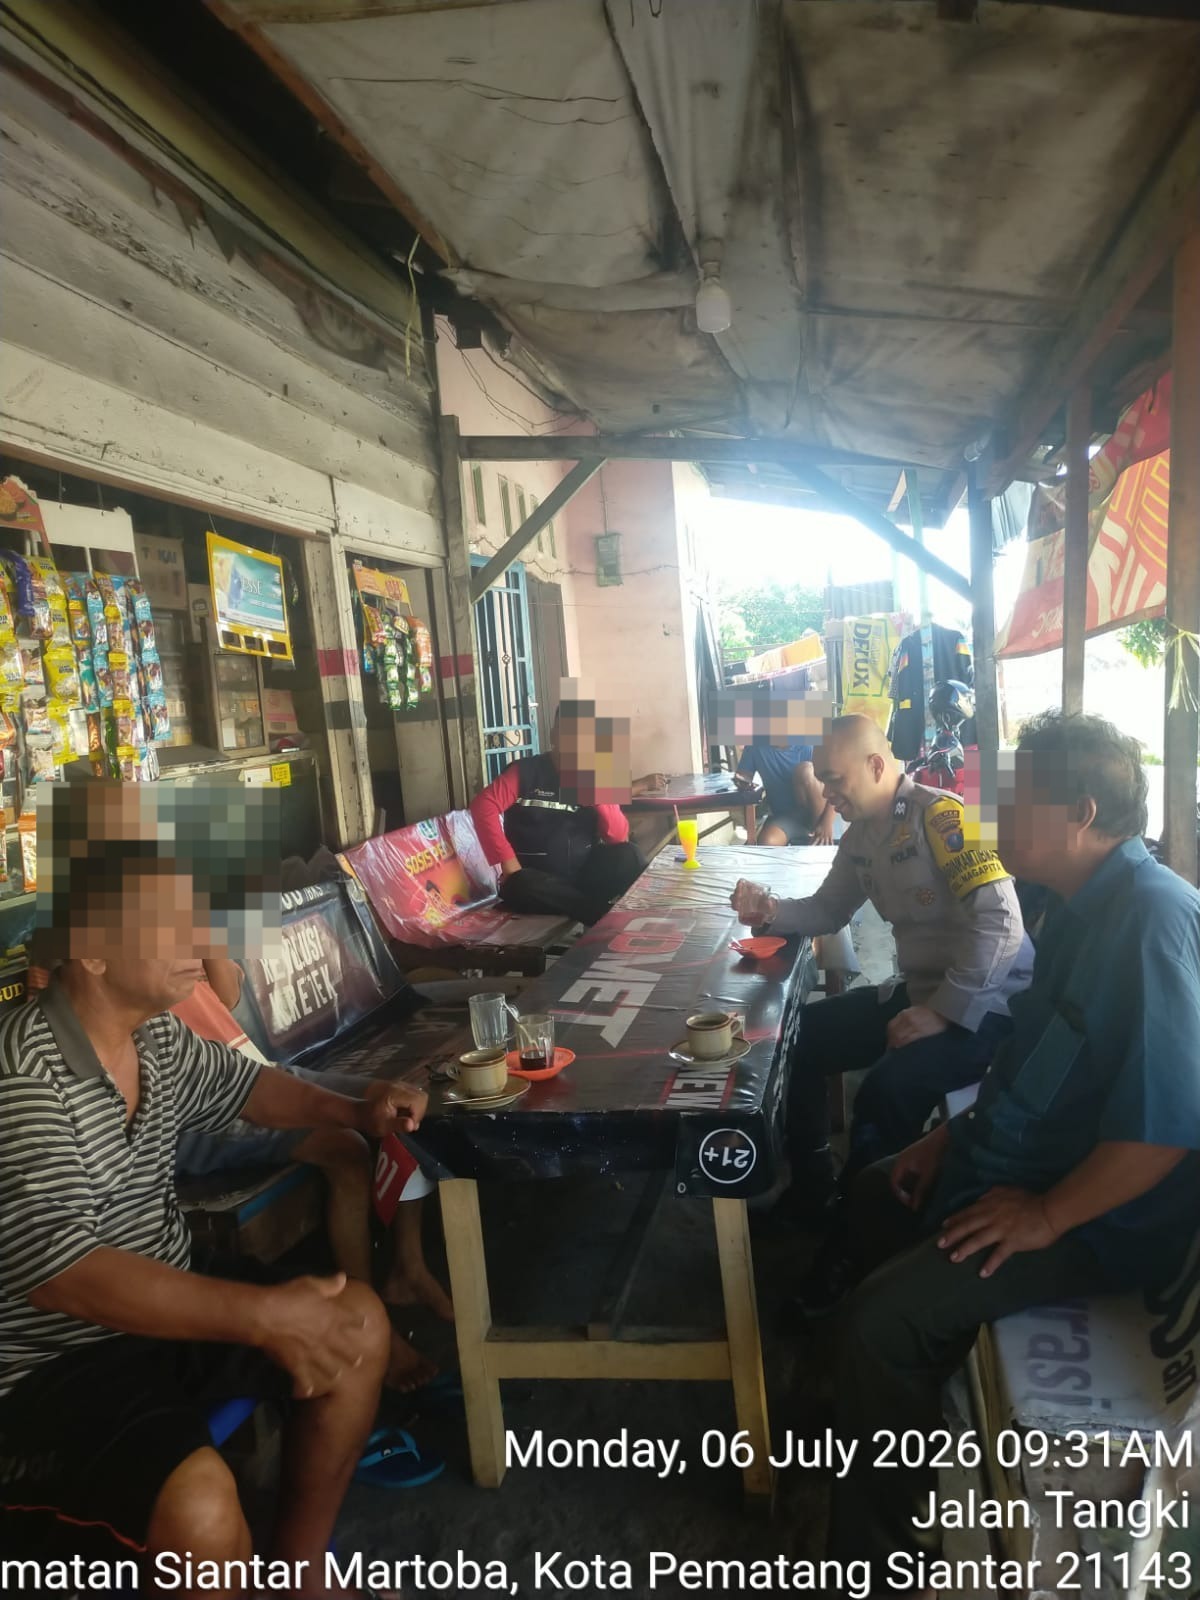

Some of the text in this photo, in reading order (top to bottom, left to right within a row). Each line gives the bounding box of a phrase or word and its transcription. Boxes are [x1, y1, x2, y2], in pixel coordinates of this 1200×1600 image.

[405, 853, 434, 876] SOSIS
[552, 917, 696, 1049] COMET
[703, 1145, 750, 1169] 21+
